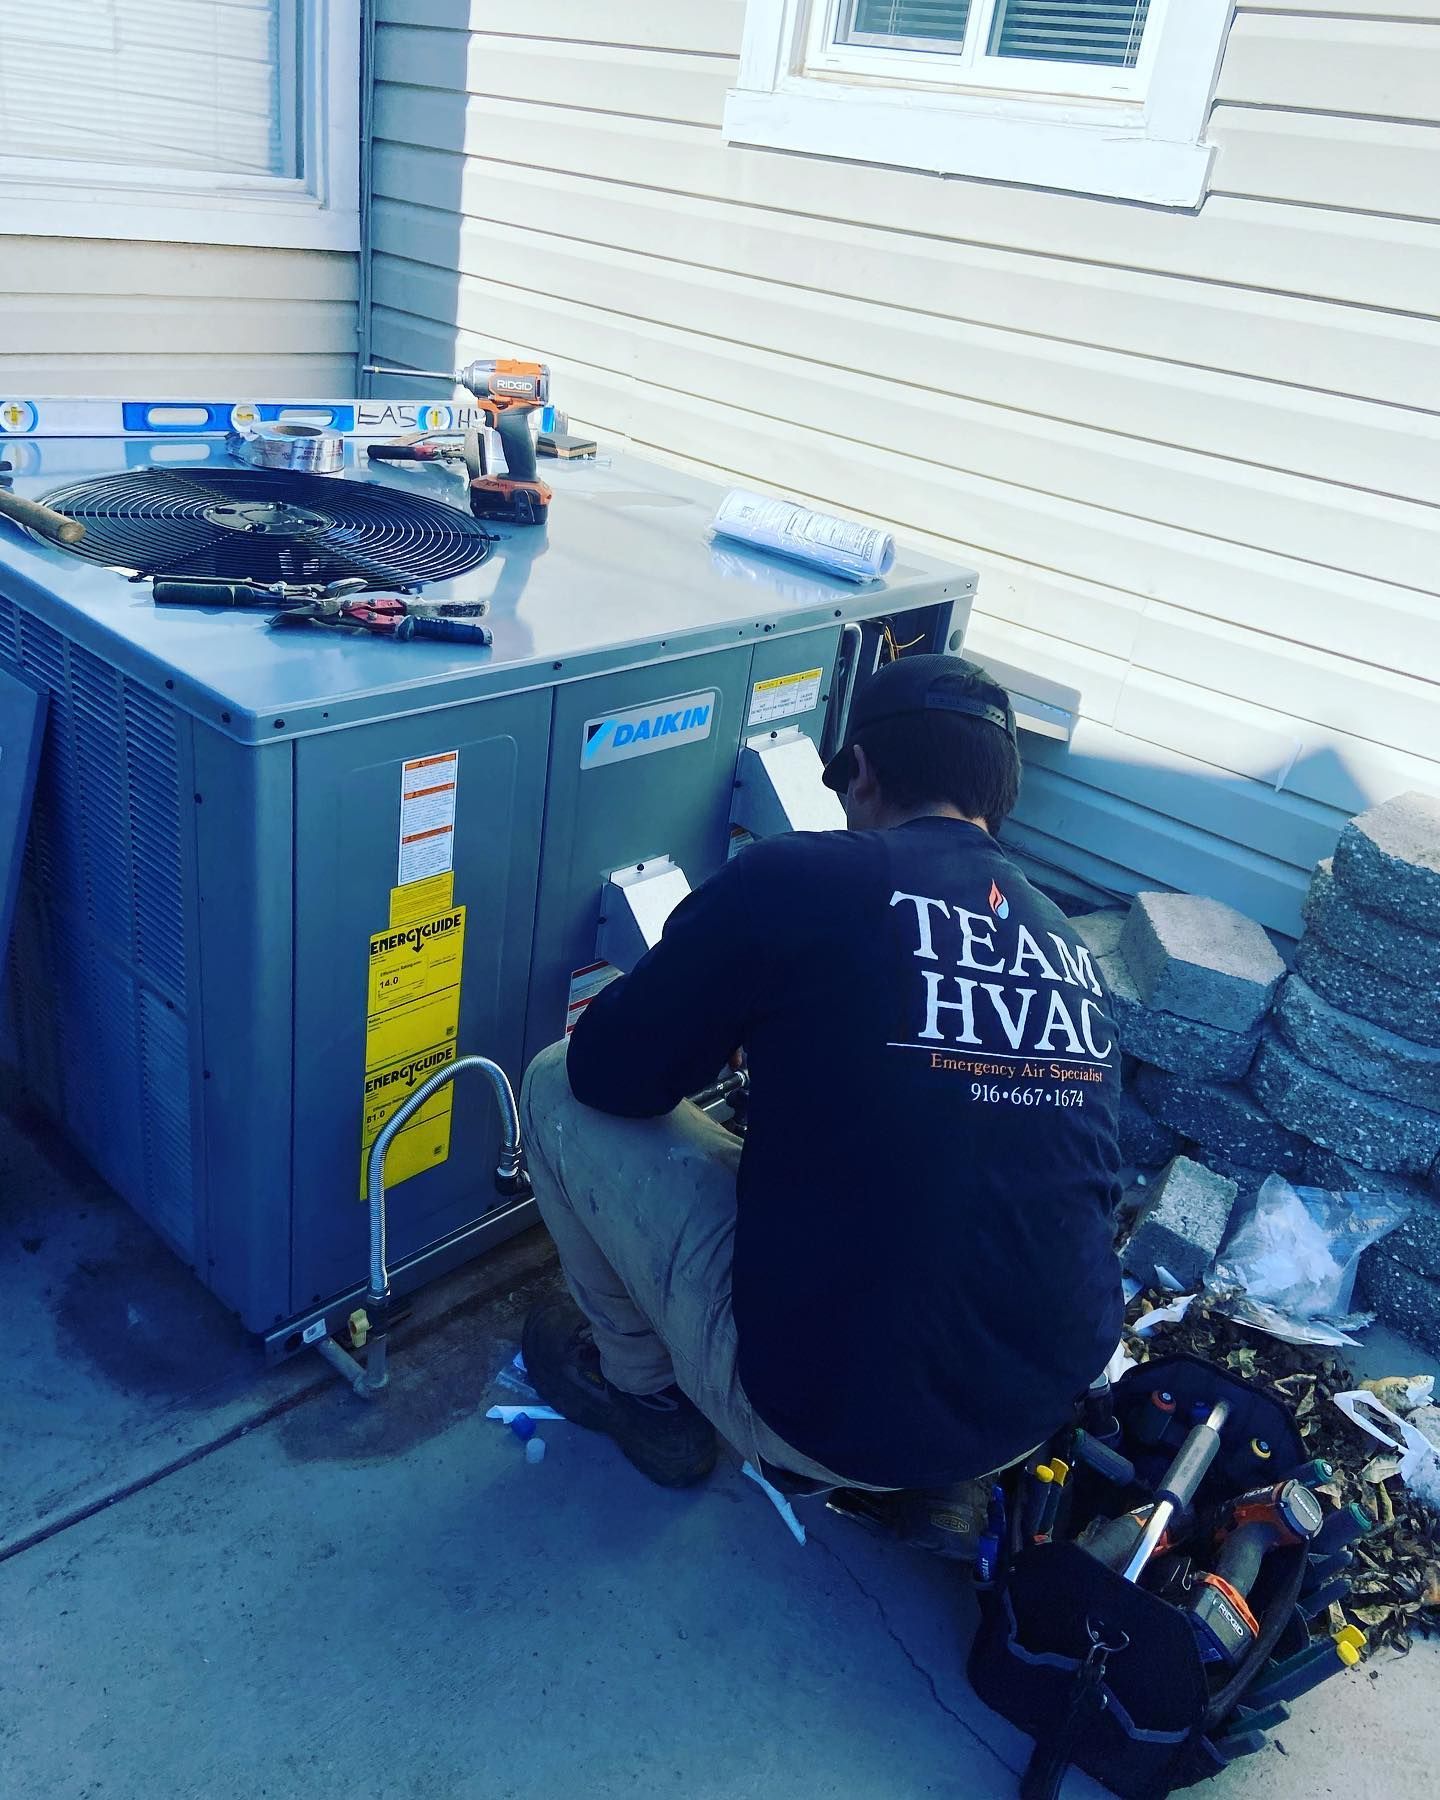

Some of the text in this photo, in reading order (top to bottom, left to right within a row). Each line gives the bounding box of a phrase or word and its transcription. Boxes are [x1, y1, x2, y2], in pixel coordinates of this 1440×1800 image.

[496, 379, 533, 391] RIDGID
[612, 705, 710, 748] DAIKIN
[370, 914, 461, 955] ENERGYGUIDE
[889, 891, 1103, 997] TEAM
[380, 976, 398, 988] 14.0
[918, 971, 1112, 1059] HVAC
[365, 1047, 453, 1093] ENERGYGUIDE
[930, 1053, 1103, 1082] Emergency Air Specialist
[366, 1110, 385, 1124] 81.0
[1218, 1603, 1244, 1636] RIDGID
